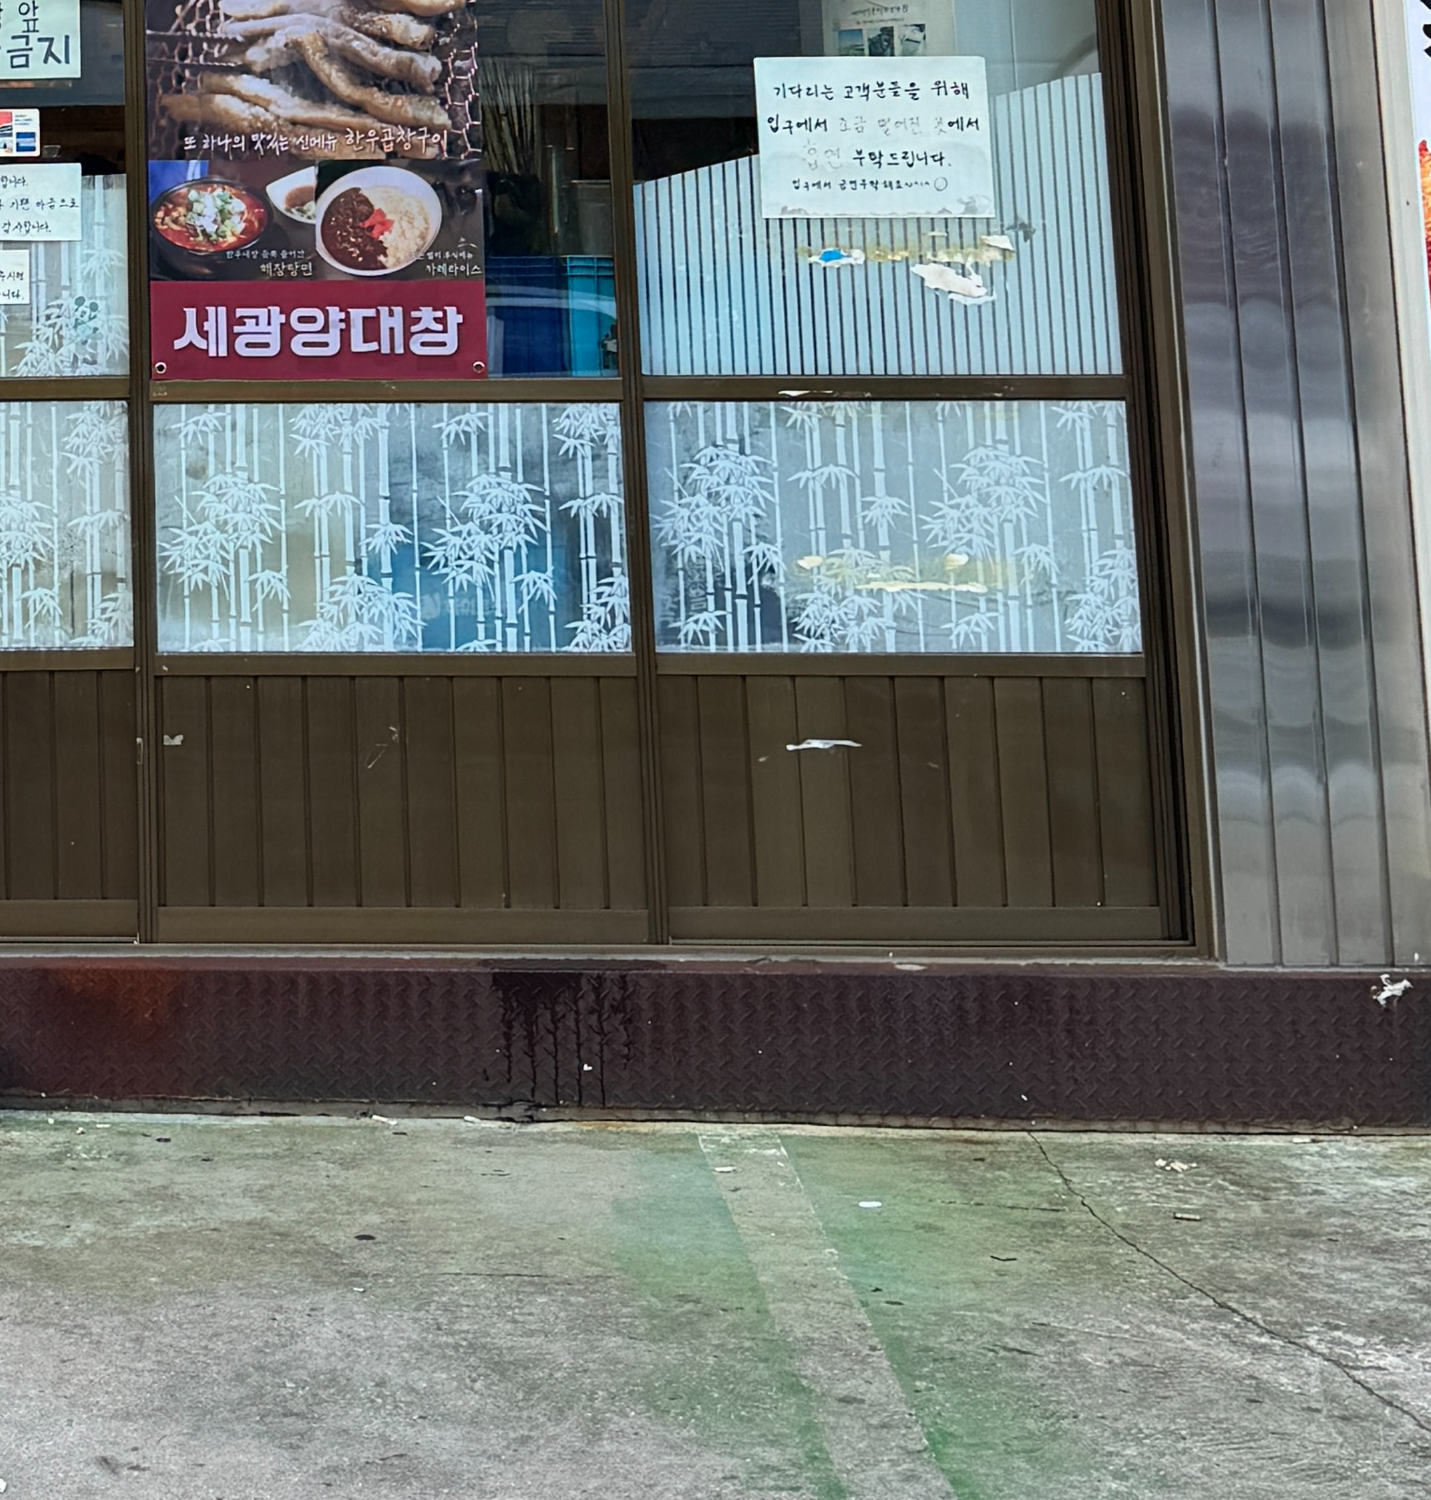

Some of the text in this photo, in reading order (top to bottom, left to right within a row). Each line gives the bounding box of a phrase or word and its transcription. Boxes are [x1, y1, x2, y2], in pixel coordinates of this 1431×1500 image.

[18, 0, 40, 33] 앞
[773, 79, 970, 102] 기다리는 고객분들을 위해
[766, 114, 828, 135] 입구에서
[183, 127, 449, 158] 또 하나의 맛있는 신메뉴 한우곱창구이
[791, 178, 832, 192] 입구에서
[259, 261, 313, 277] 해장탕면
[425, 262, 483, 277] 카레라이스
[173, 305, 463, 358] 세광양대창
